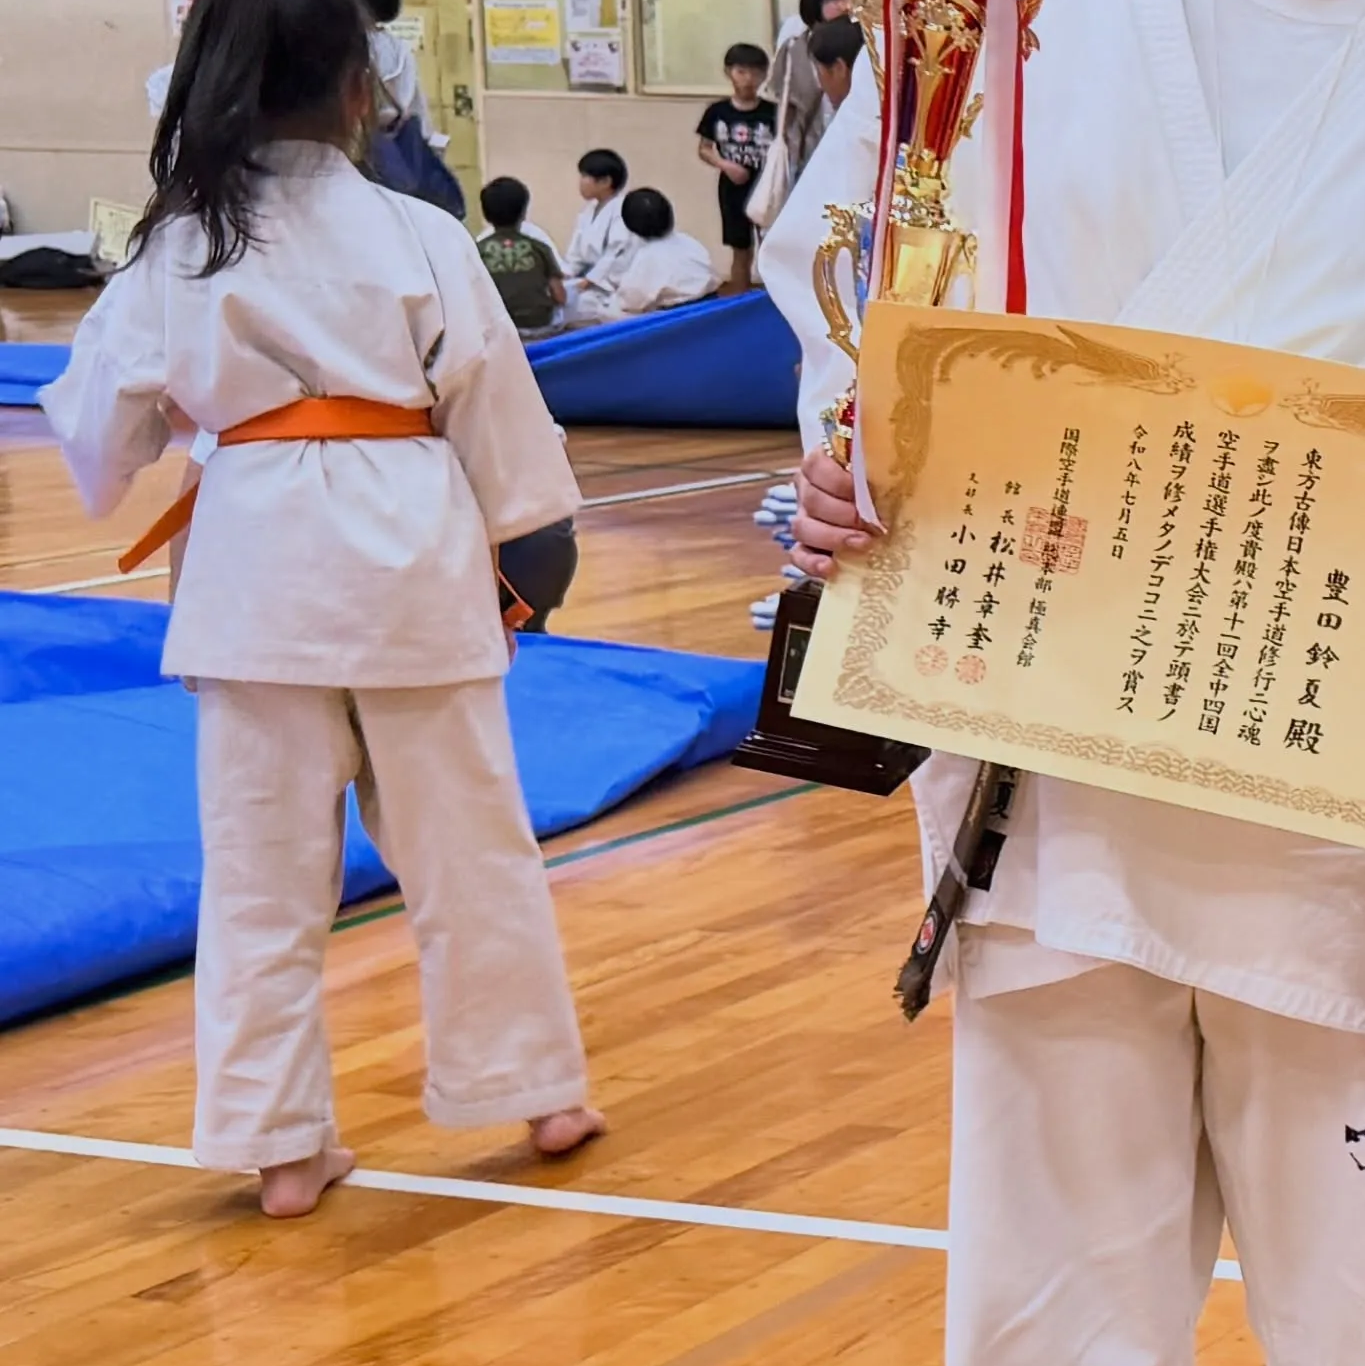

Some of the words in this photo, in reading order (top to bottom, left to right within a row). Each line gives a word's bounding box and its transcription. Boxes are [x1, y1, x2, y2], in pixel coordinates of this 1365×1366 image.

[1111, 423, 1150, 560] 令和八年七月五日
